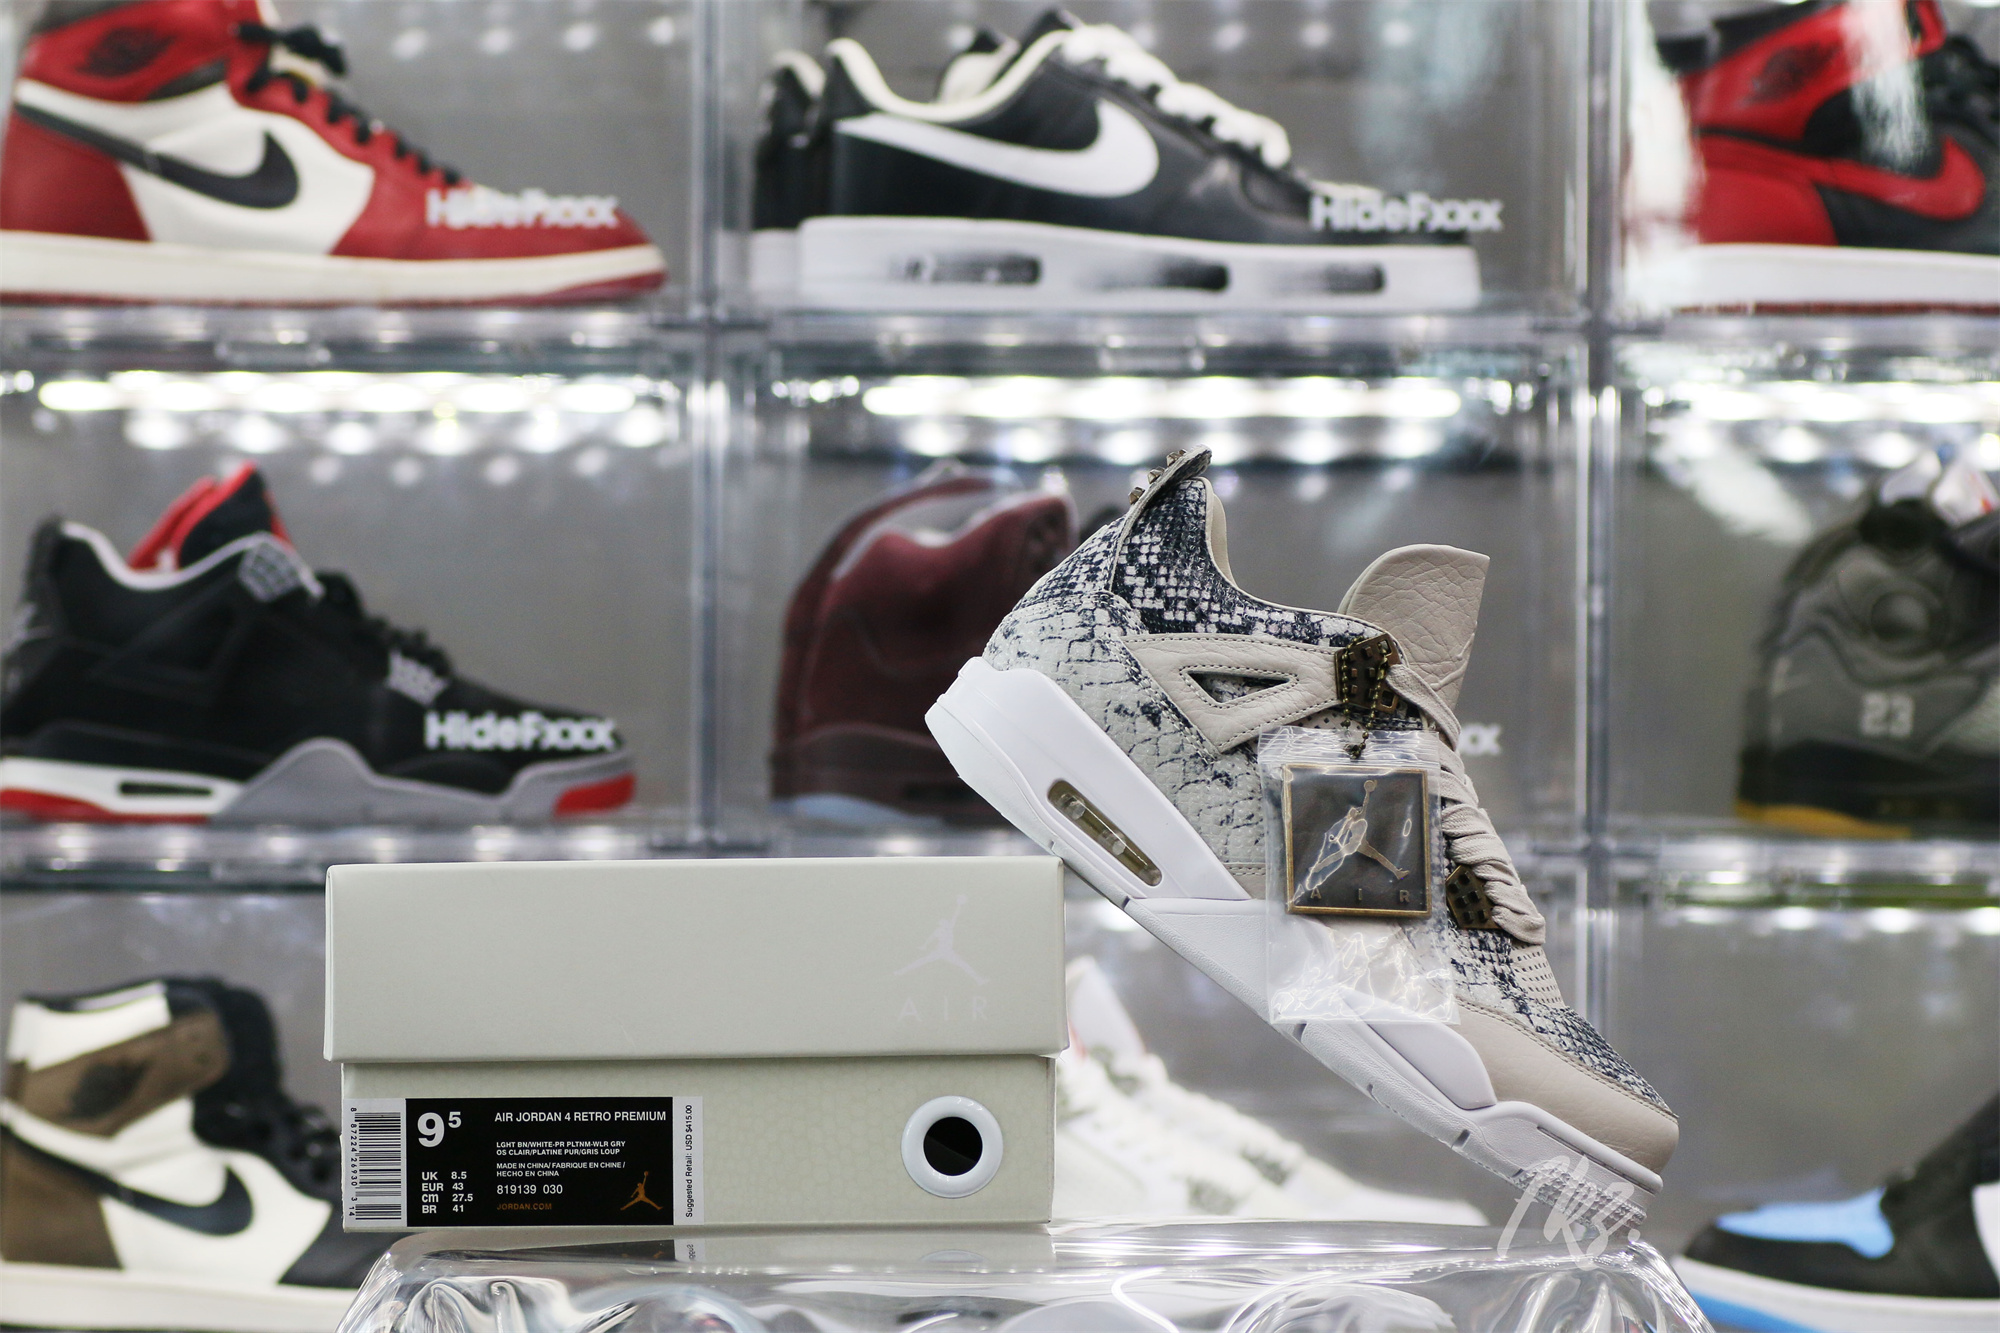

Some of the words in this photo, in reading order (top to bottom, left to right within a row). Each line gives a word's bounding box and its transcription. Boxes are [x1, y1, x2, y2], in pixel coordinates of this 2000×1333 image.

[1861, 690, 1914, 737] 23
[1310, 886, 1411, 903] AIR
[898, 995, 988, 1022] AIR
[495, 1112, 514, 1122] AIR
[516, 1112, 562, 1122] JORDAN
[564, 1112, 571, 1122] 4
[573, 1111, 612, 1121] RETRO
[614, 1111, 667, 1121] PREMIUM
[685, 1104, 693, 1133] $415.00
[685, 1134, 693, 1151] USD
[685, 1153, 693, 1177] Retail:
[421, 1171, 438, 1181] UK
[451, 1171, 467, 1180] 8.5
[421, 1182, 444, 1192] EUR
[452, 1182, 464, 1191] 43
[497, 1184, 537, 1195] 819139
[543, 1184, 563, 1194] 030
[421, 1193, 439, 1203] cm
[452, 1193, 473, 1202] 27.5
[685, 1179, 695, 1218] Suggested
[422, 1204, 437, 1214] BR
[452, 1204, 464, 1213] 41
[497, 1203, 553, 1211] JORDAN.COM
